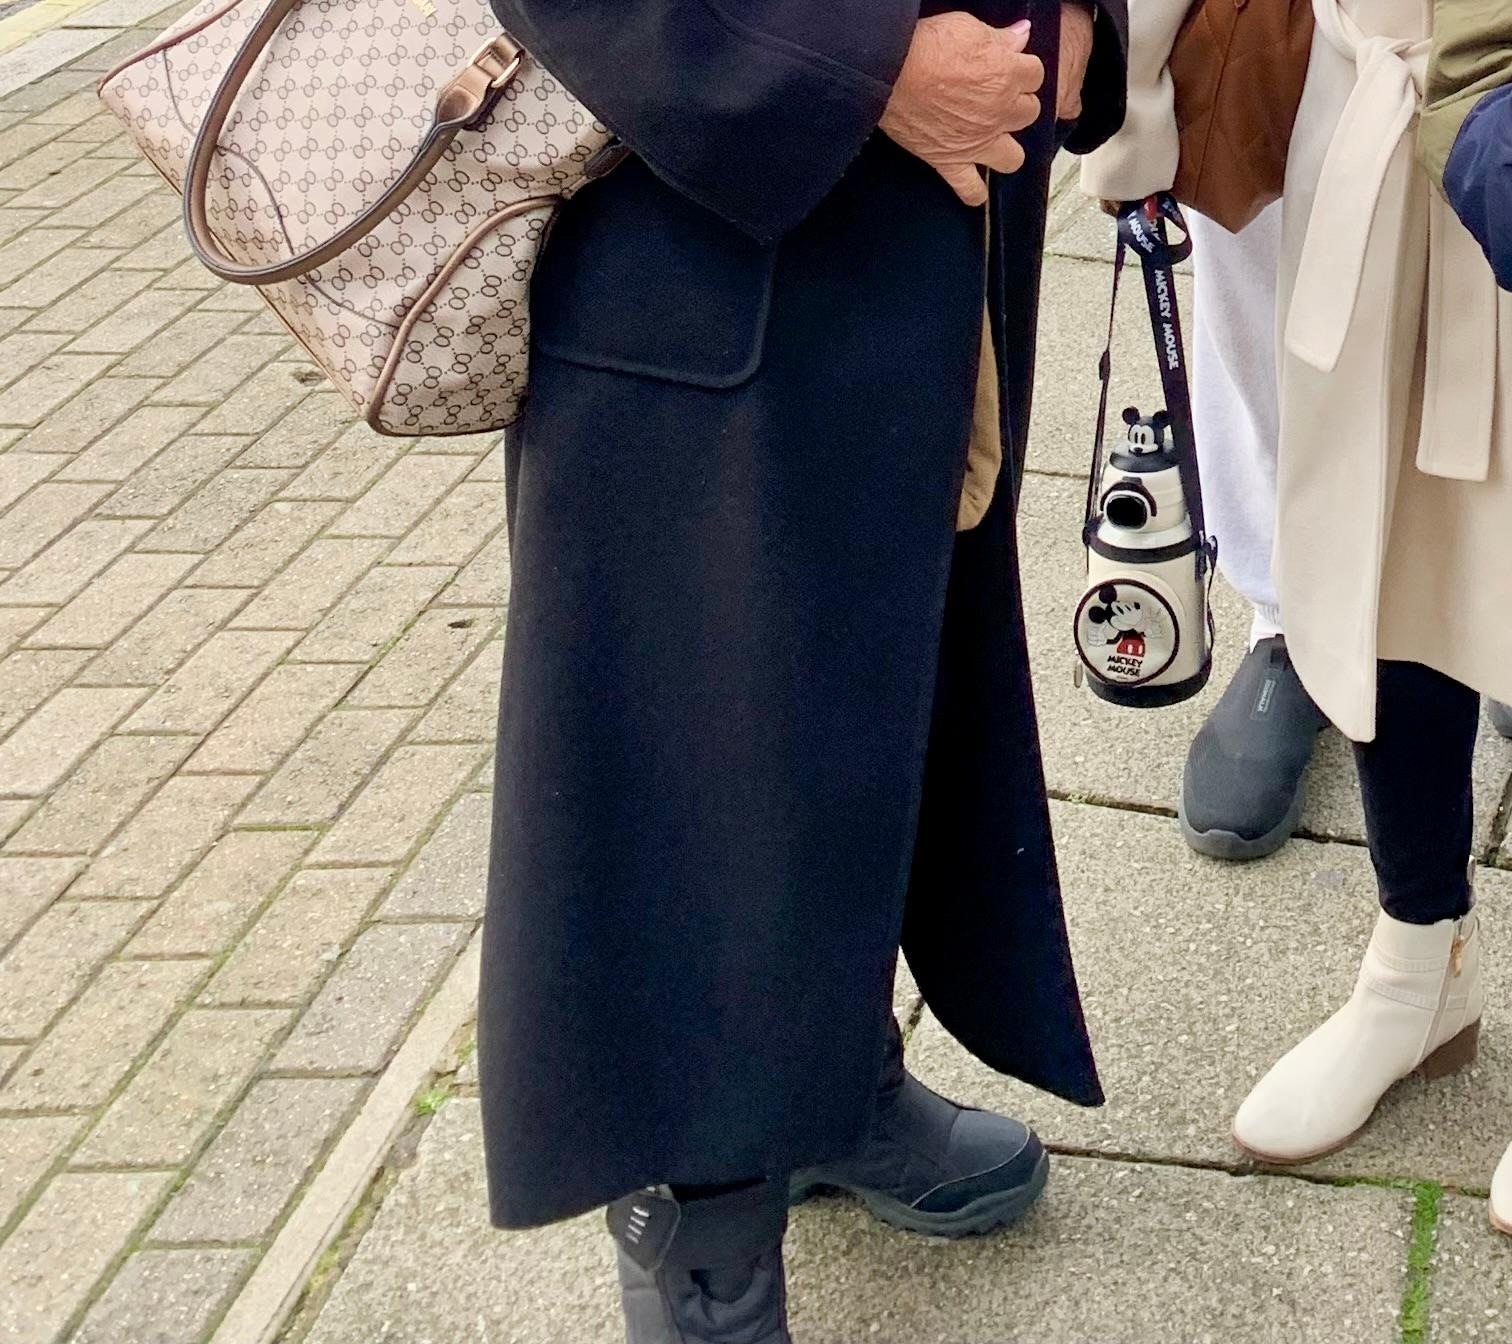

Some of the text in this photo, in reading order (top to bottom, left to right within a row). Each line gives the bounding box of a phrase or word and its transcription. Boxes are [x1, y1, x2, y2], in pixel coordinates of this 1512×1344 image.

[1155, 269, 1179, 370] MICKEY MOUSE
[1107, 655, 1143, 668] MICKEY
[1107, 665, 1141, 678] MOUSE
